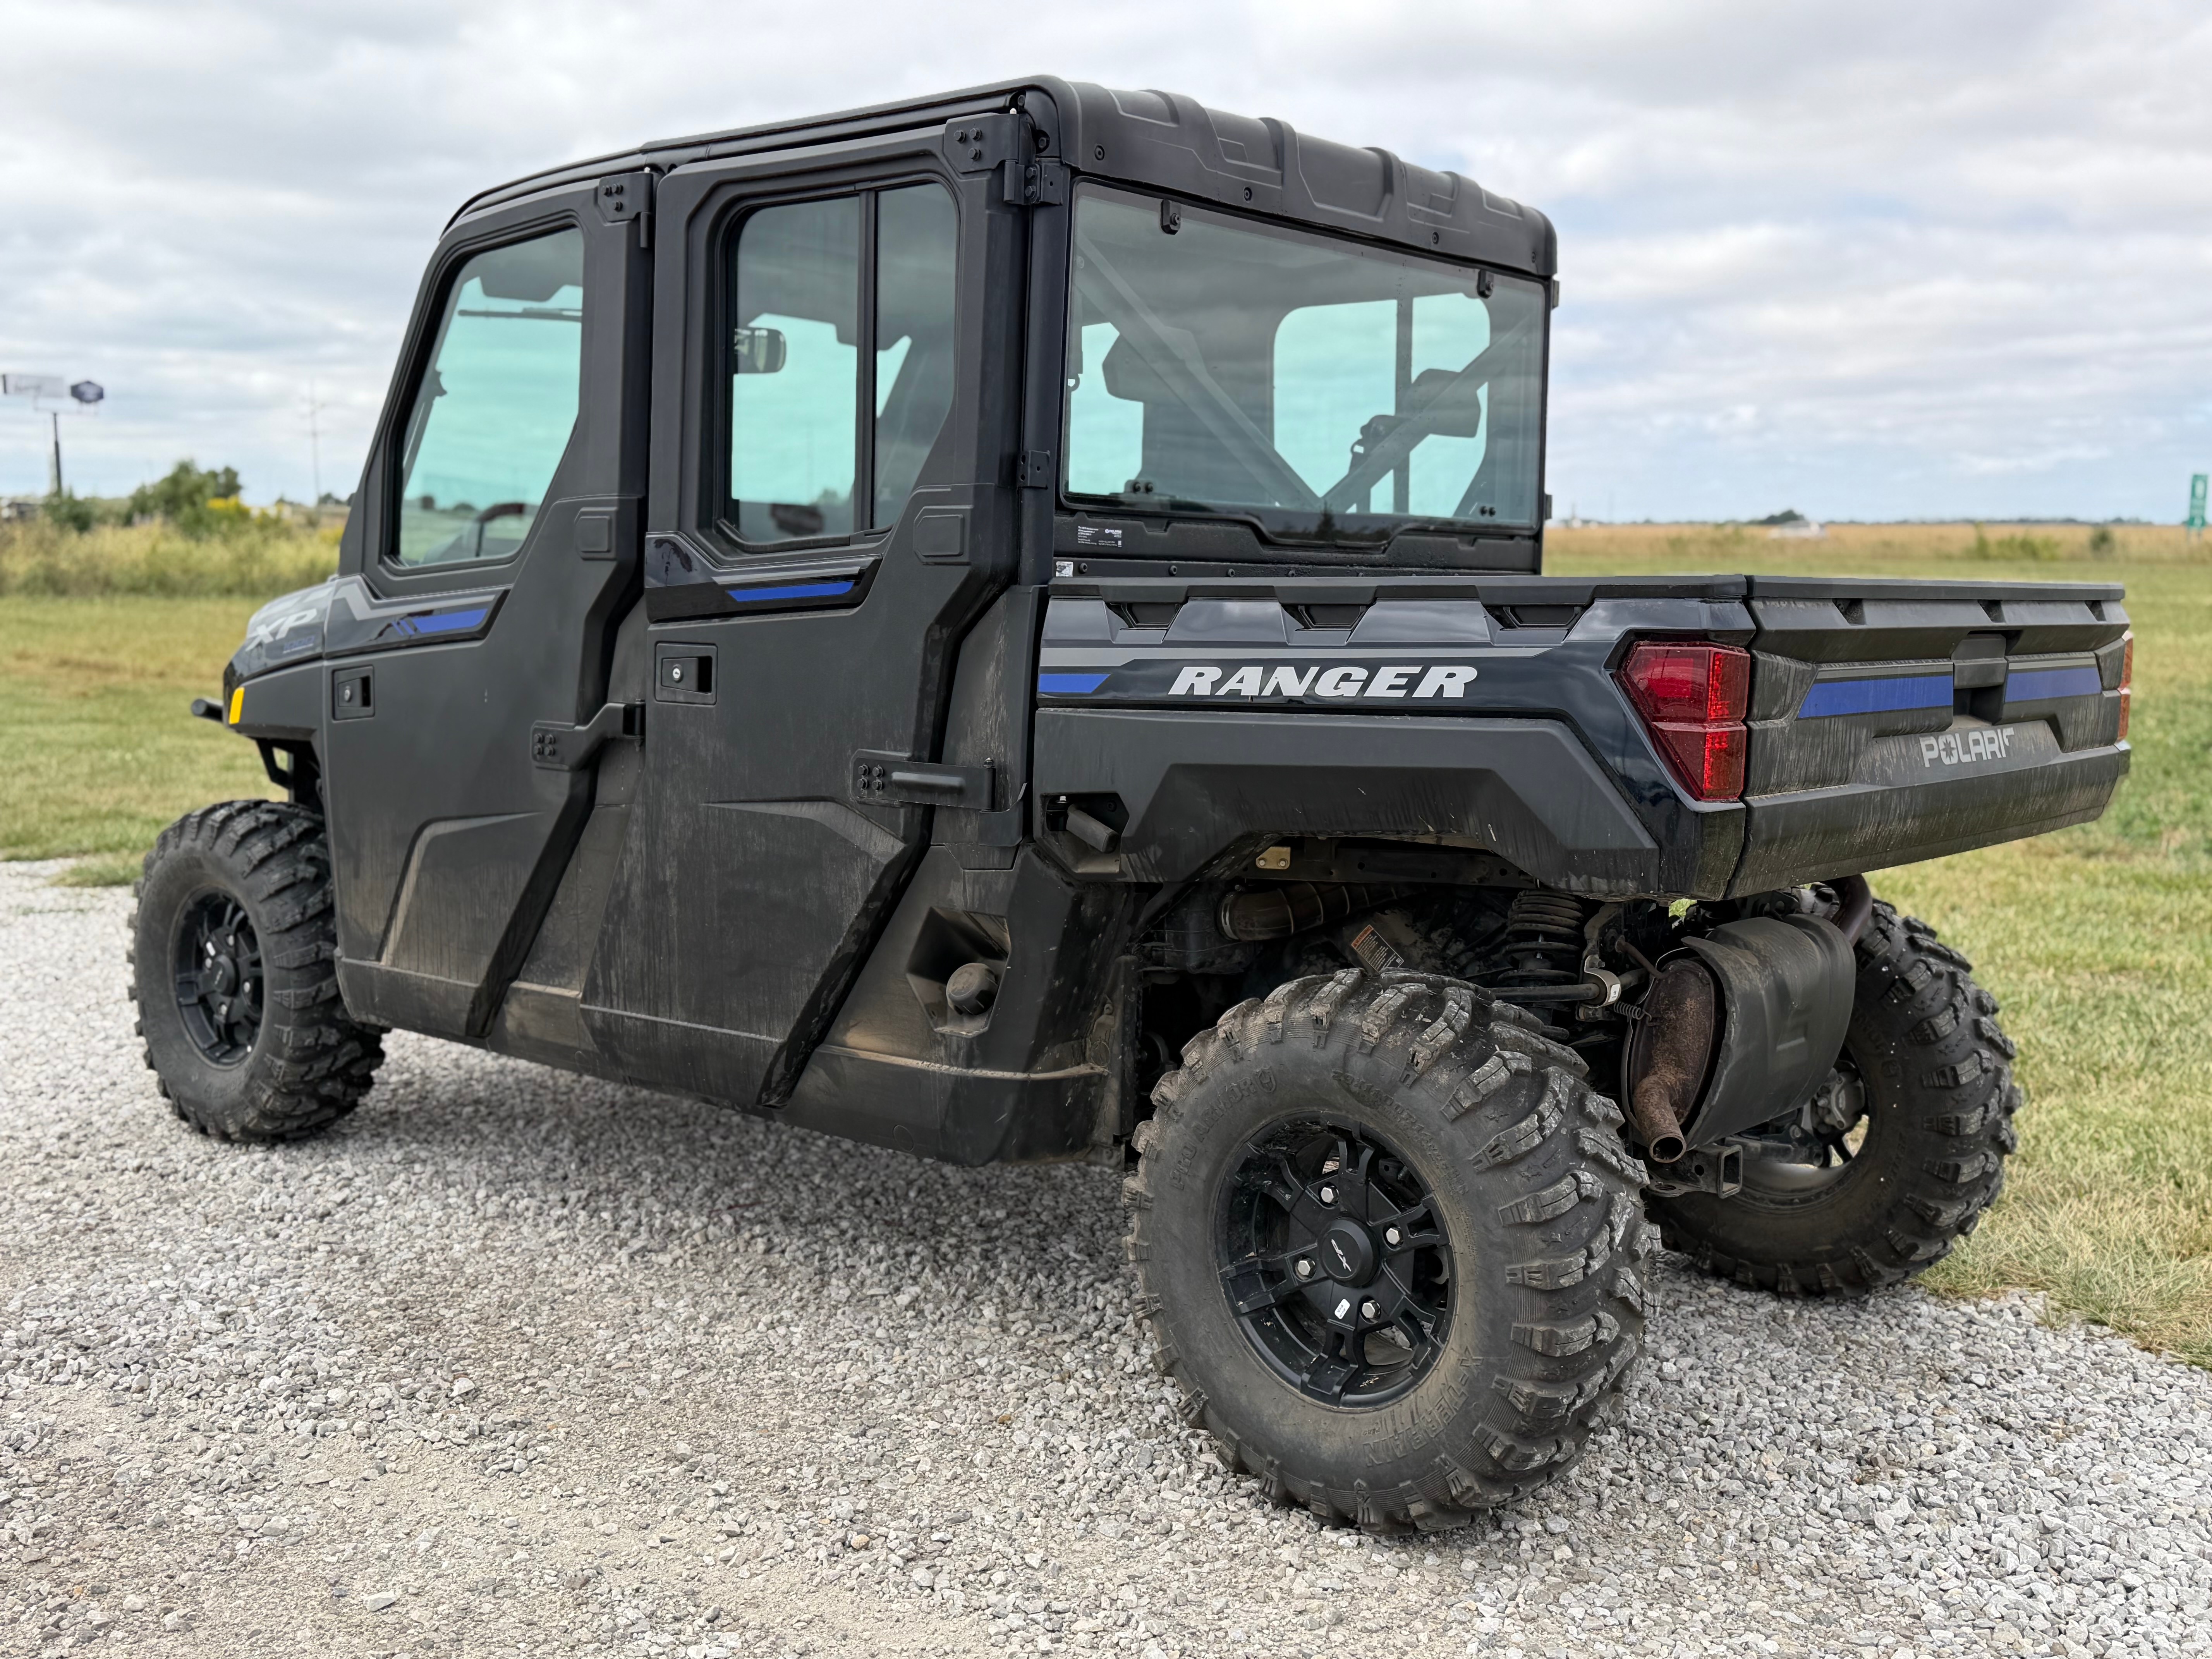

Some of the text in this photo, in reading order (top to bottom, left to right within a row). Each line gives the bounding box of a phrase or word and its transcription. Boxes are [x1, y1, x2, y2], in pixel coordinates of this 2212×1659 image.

[244, 607, 317, 652] XP
[284, 637, 315, 650] 1000
[1168, 666, 1477, 697] RANGER
[1170, 1077, 1257, 1190] PRO ARMOR
[1331, 1238, 1352, 1272] XP
